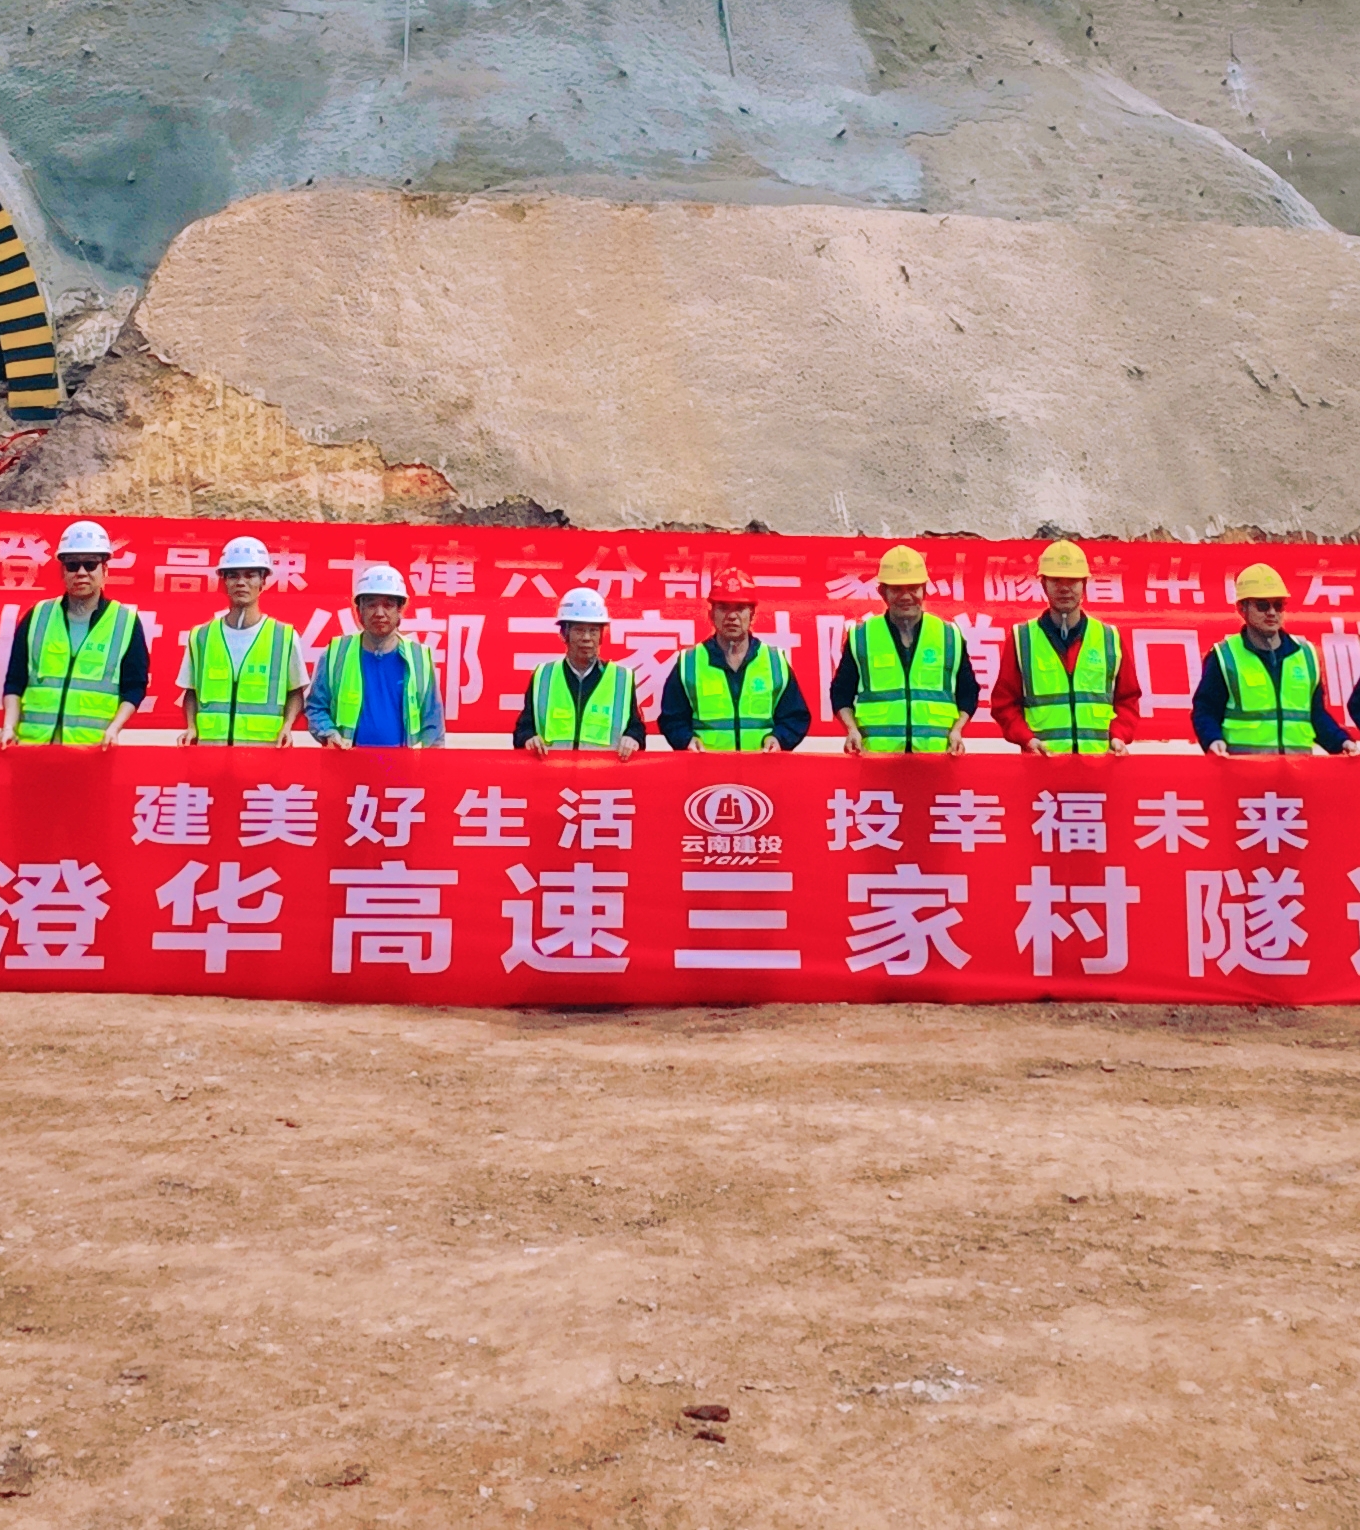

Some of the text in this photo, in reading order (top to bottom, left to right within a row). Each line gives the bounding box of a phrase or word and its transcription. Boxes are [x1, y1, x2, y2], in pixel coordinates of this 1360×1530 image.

[131, 782, 1310, 854] 建美好生活 投幸福未来
[681, 835, 782, 854] 云南建投
